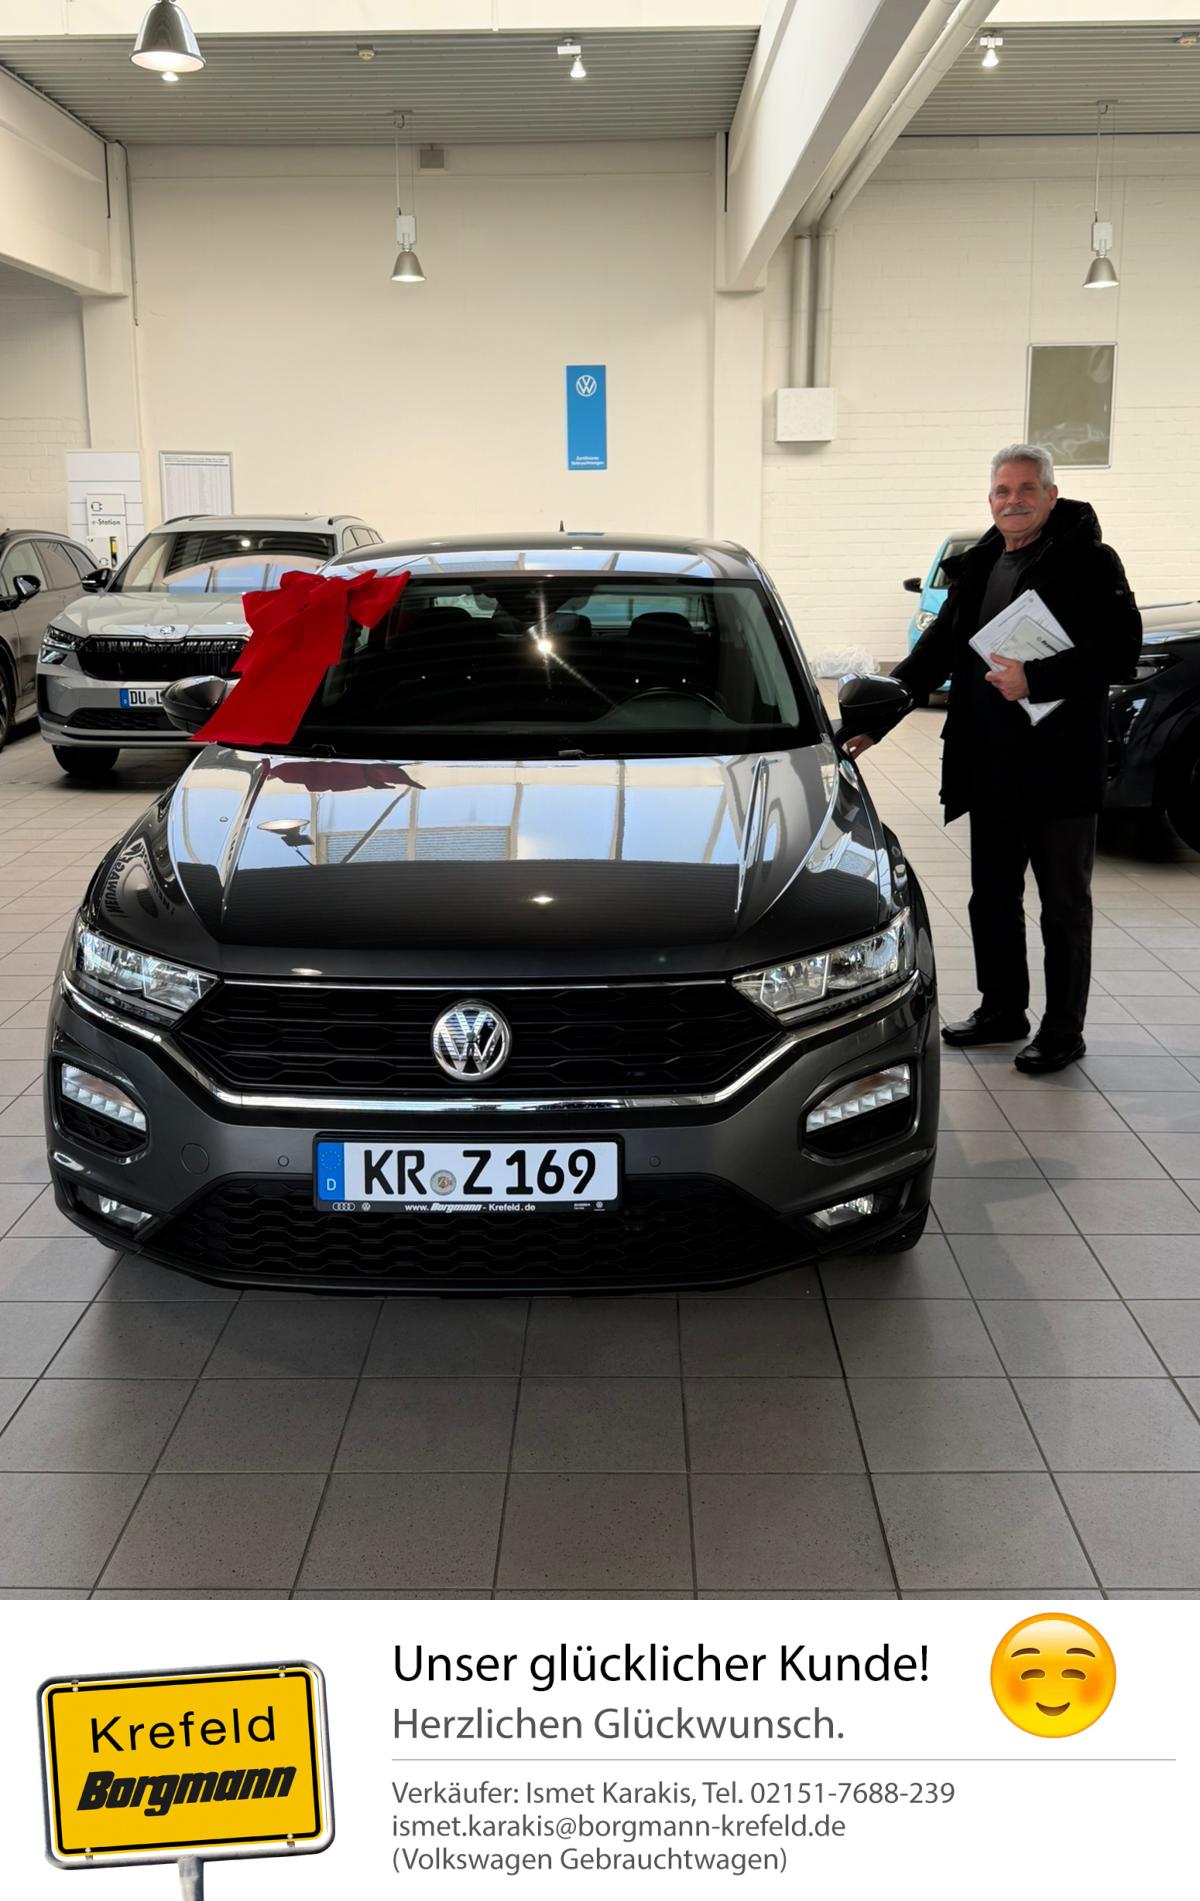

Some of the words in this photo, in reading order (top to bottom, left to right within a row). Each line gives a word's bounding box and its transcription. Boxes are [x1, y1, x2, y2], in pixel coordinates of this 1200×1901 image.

[130, 691, 147, 704] DU
[326, 1178, 337, 1191] D
[364, 1149, 427, 1195] KR
[462, 1150, 493, 1195] Z
[506, 1148, 596, 1195] 169
